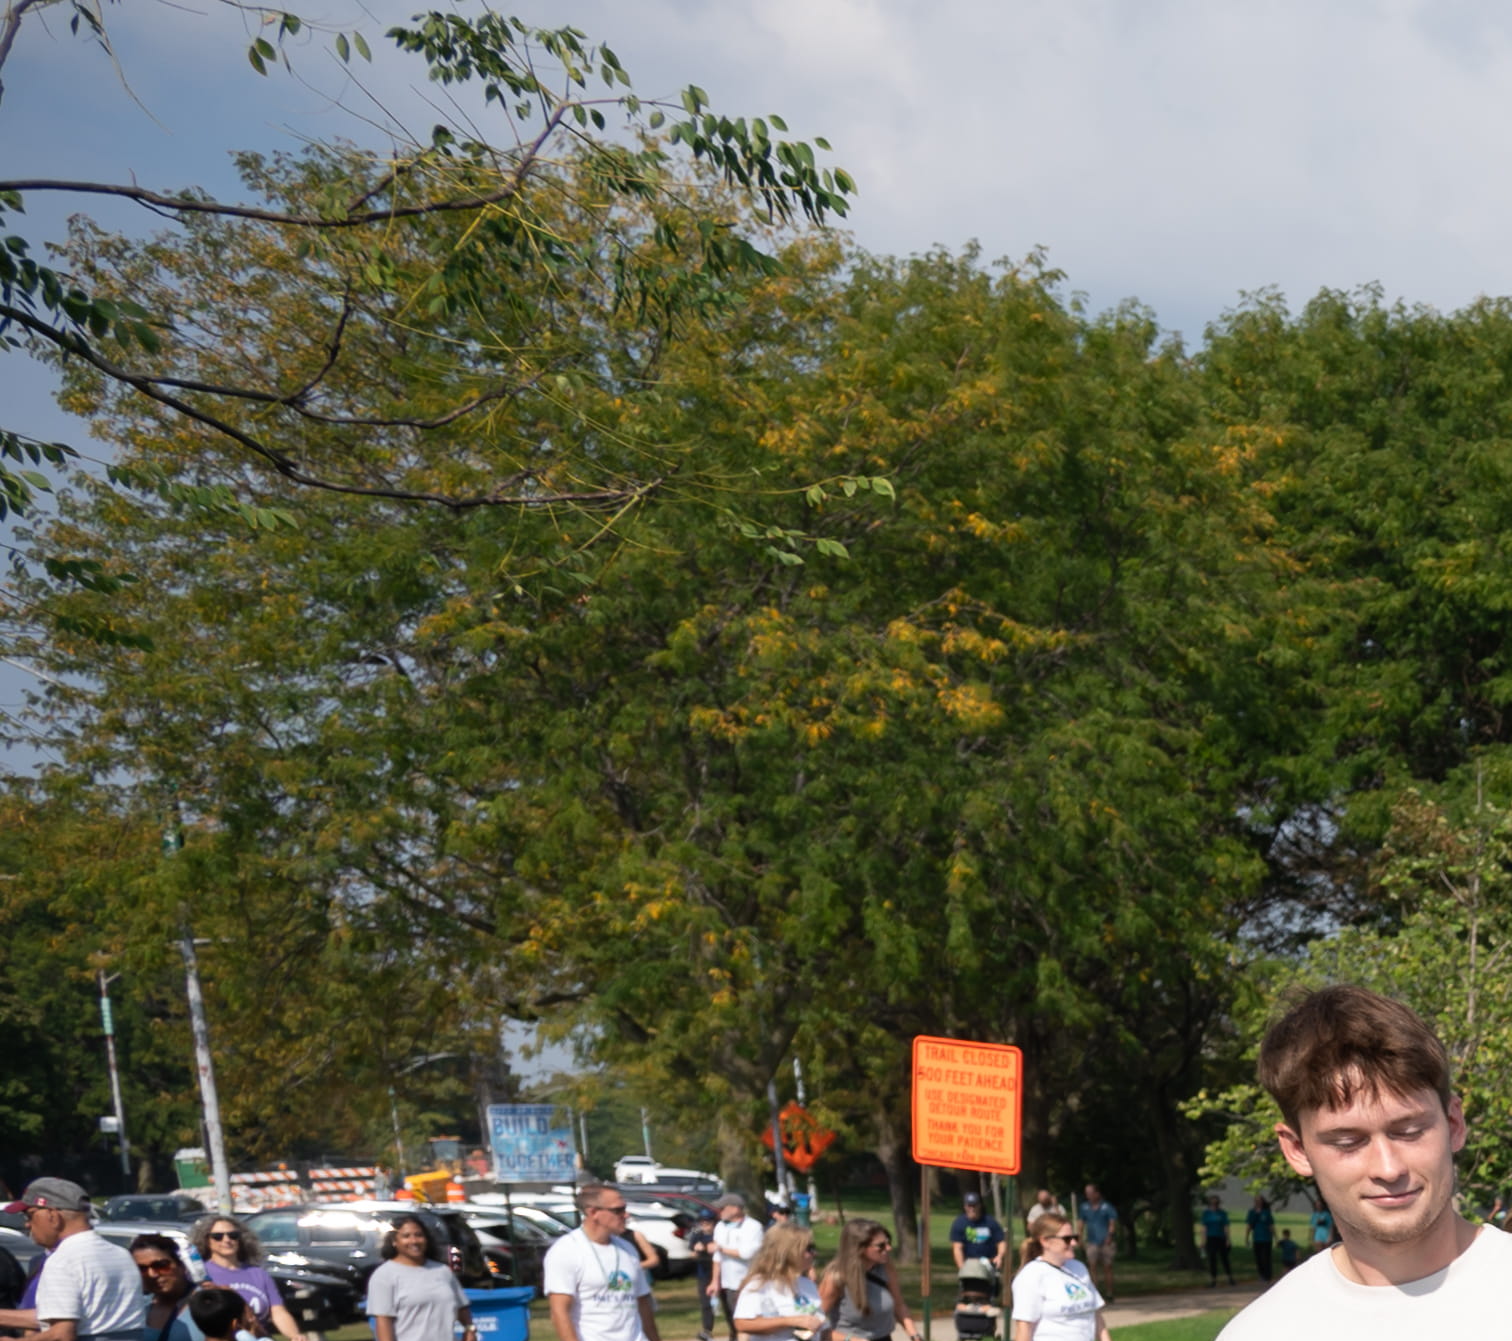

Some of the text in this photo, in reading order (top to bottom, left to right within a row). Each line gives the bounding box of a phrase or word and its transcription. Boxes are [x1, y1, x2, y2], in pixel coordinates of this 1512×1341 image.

[924, 1044, 1010, 1068] TRAIL CLOSED
[945, 1068, 974, 1086] FEET
[975, 1073, 1016, 1092] AHEAD
[928, 1118, 1005, 1138] THANK YOU FOR
[928, 1132, 1004, 1152] YOUR PATIENCE
